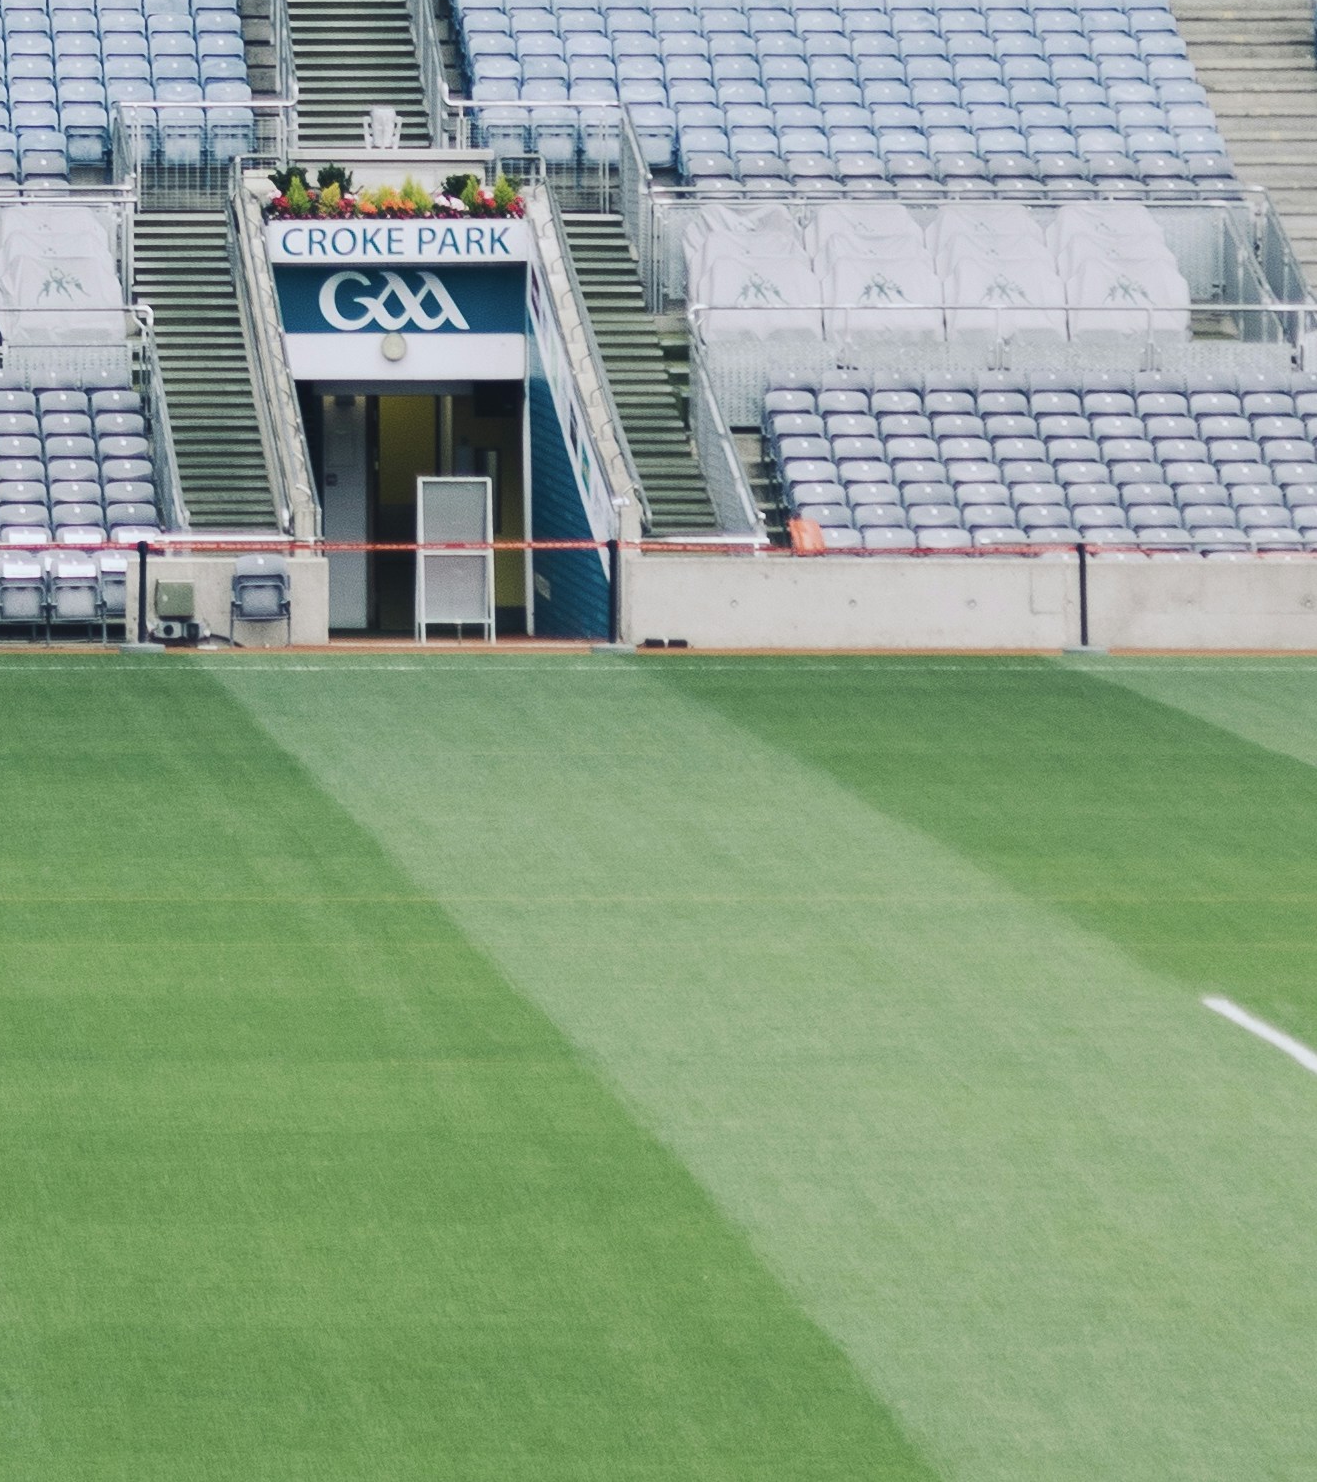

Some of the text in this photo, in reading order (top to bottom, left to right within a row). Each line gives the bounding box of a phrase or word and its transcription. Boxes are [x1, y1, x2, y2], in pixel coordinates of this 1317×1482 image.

[281, 226, 511, 256] CROKE PARK
[318, 270, 471, 331] GAA
